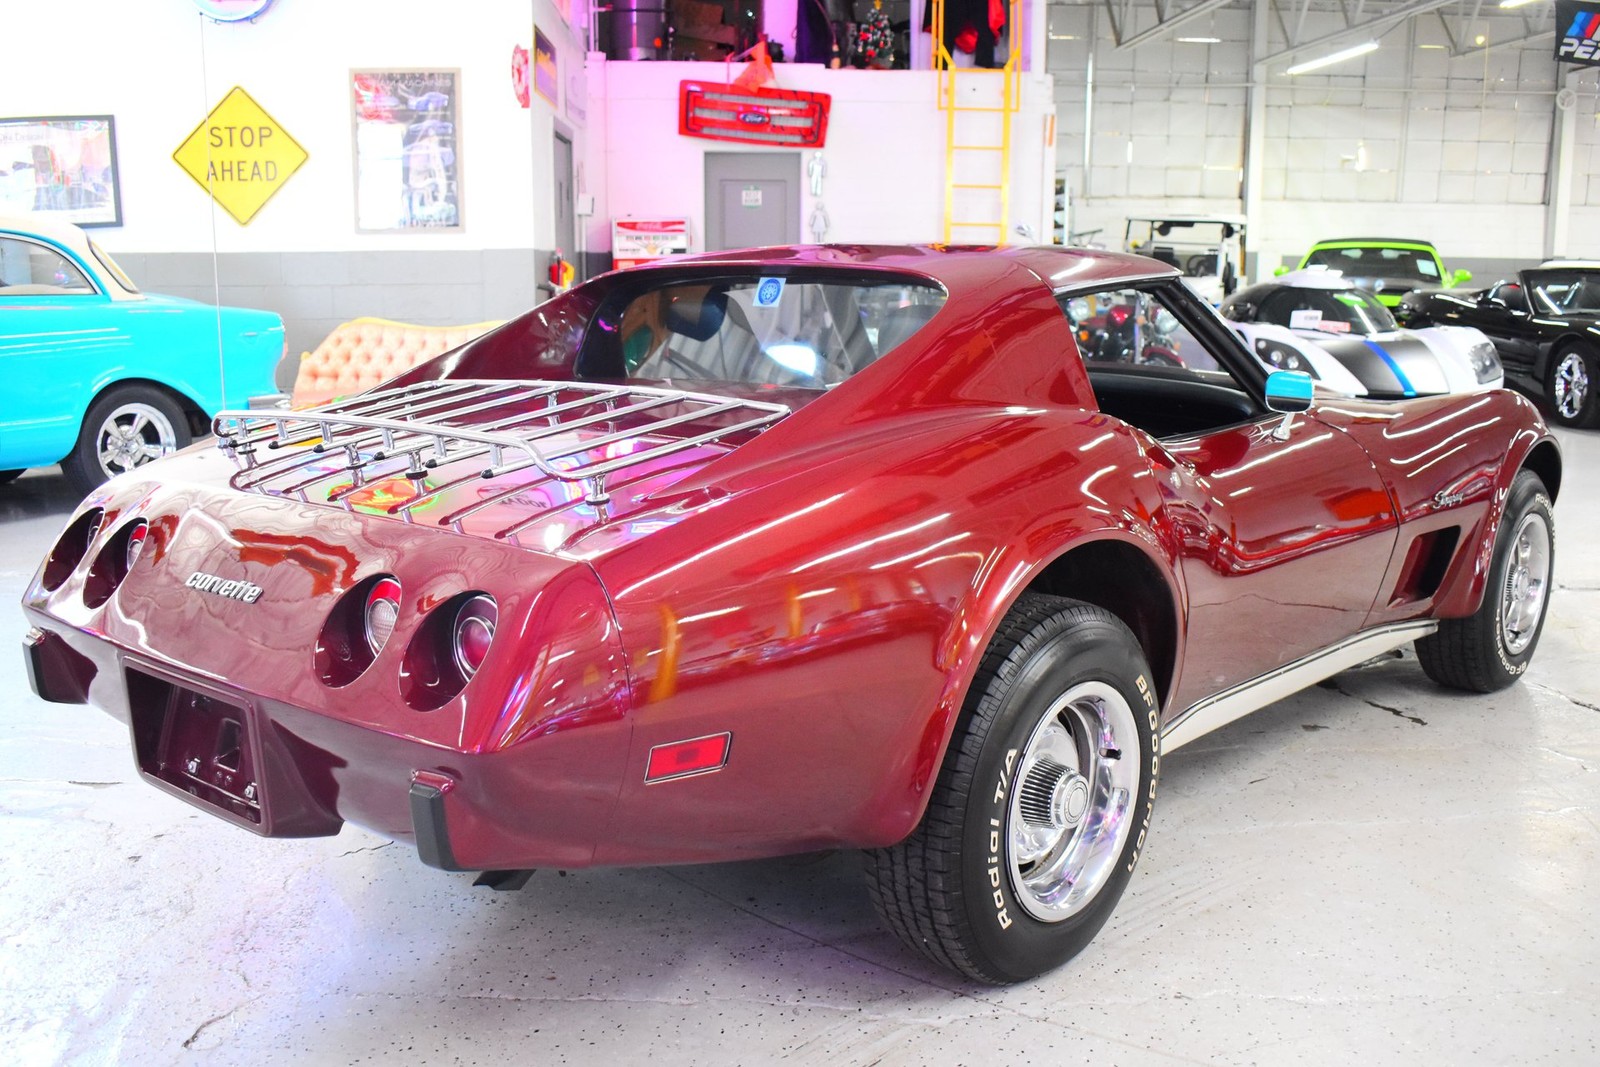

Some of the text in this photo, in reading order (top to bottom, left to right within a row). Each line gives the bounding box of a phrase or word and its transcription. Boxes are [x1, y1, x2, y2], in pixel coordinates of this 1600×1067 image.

[209, 126, 273, 148] STOP
[206, 160, 278, 182] AHEAD
[987, 748, 1018, 930] Radial T/A
